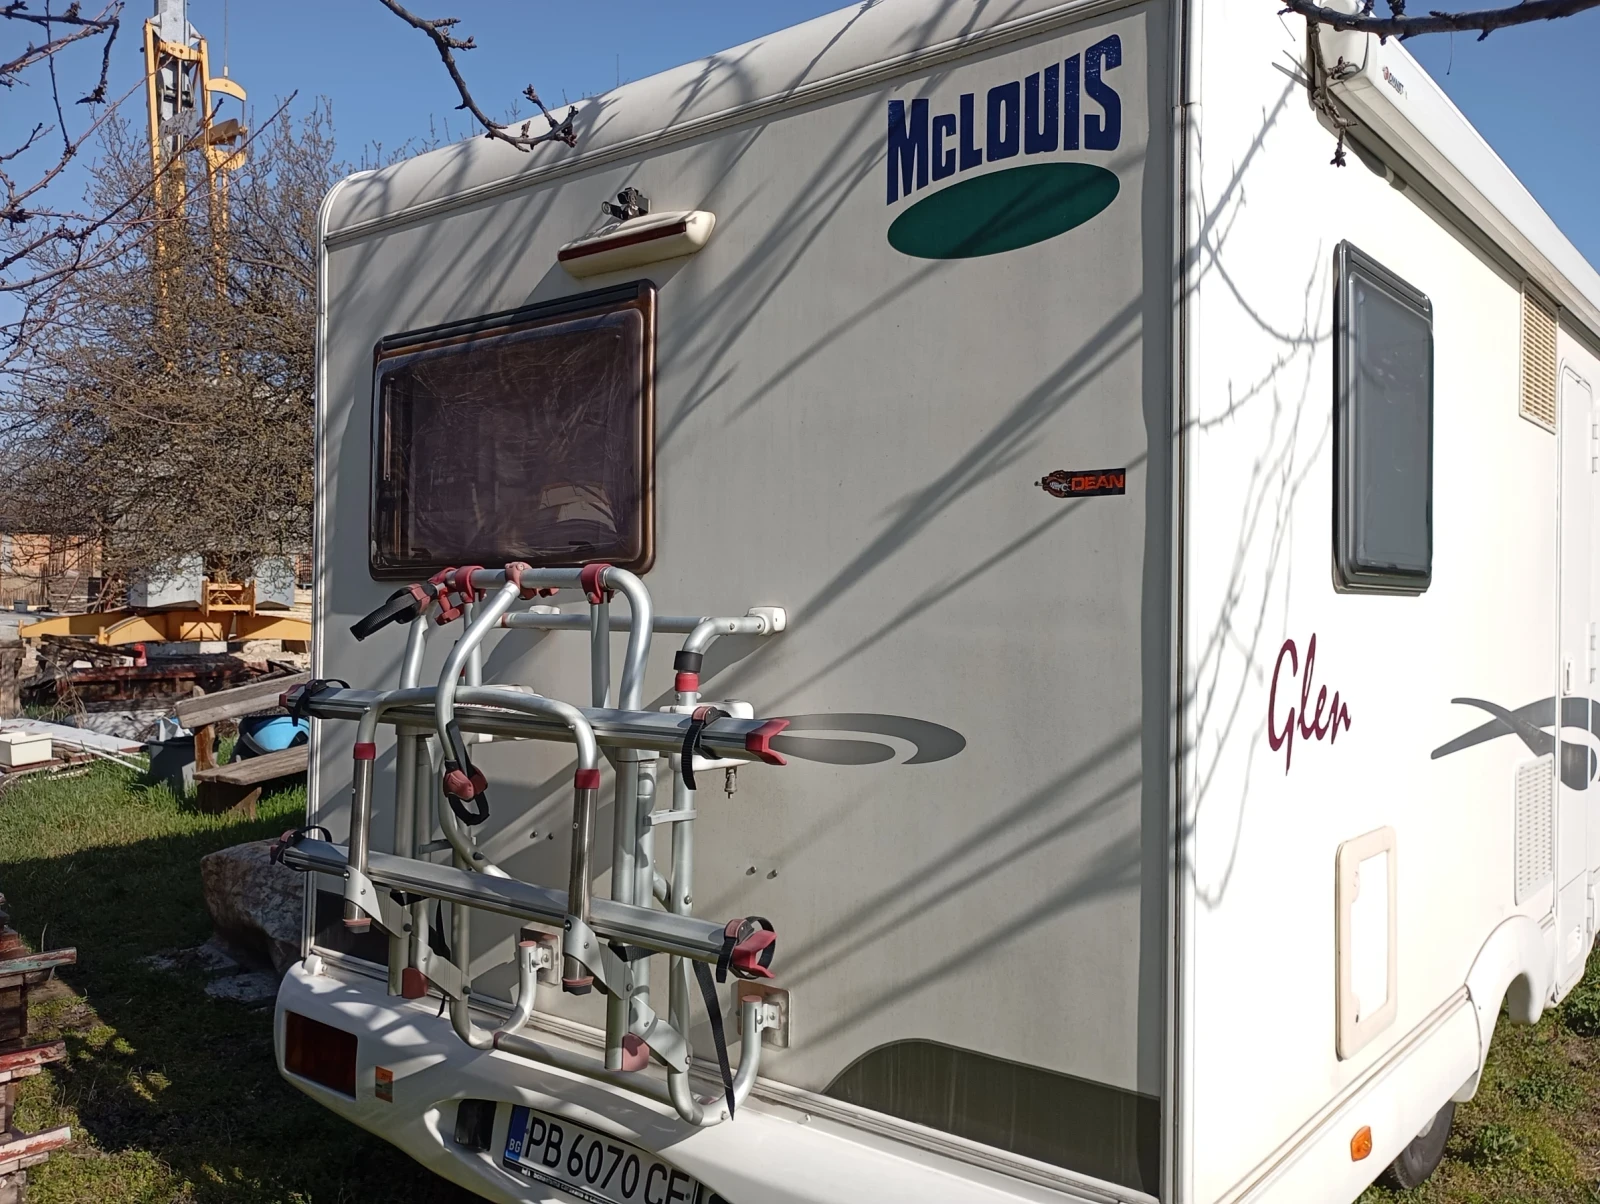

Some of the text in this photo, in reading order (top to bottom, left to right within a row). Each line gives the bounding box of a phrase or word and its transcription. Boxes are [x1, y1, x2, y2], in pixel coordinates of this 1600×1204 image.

[887, 34, 1122, 206] McLOUIS
[1071, 474, 1124, 491] DEAN
[1268, 632, 1352, 777] Glen
[508, 1138, 521, 1153] BG
[525, 1116, 564, 1169] PB
[567, 1133, 641, 1199] 6070
